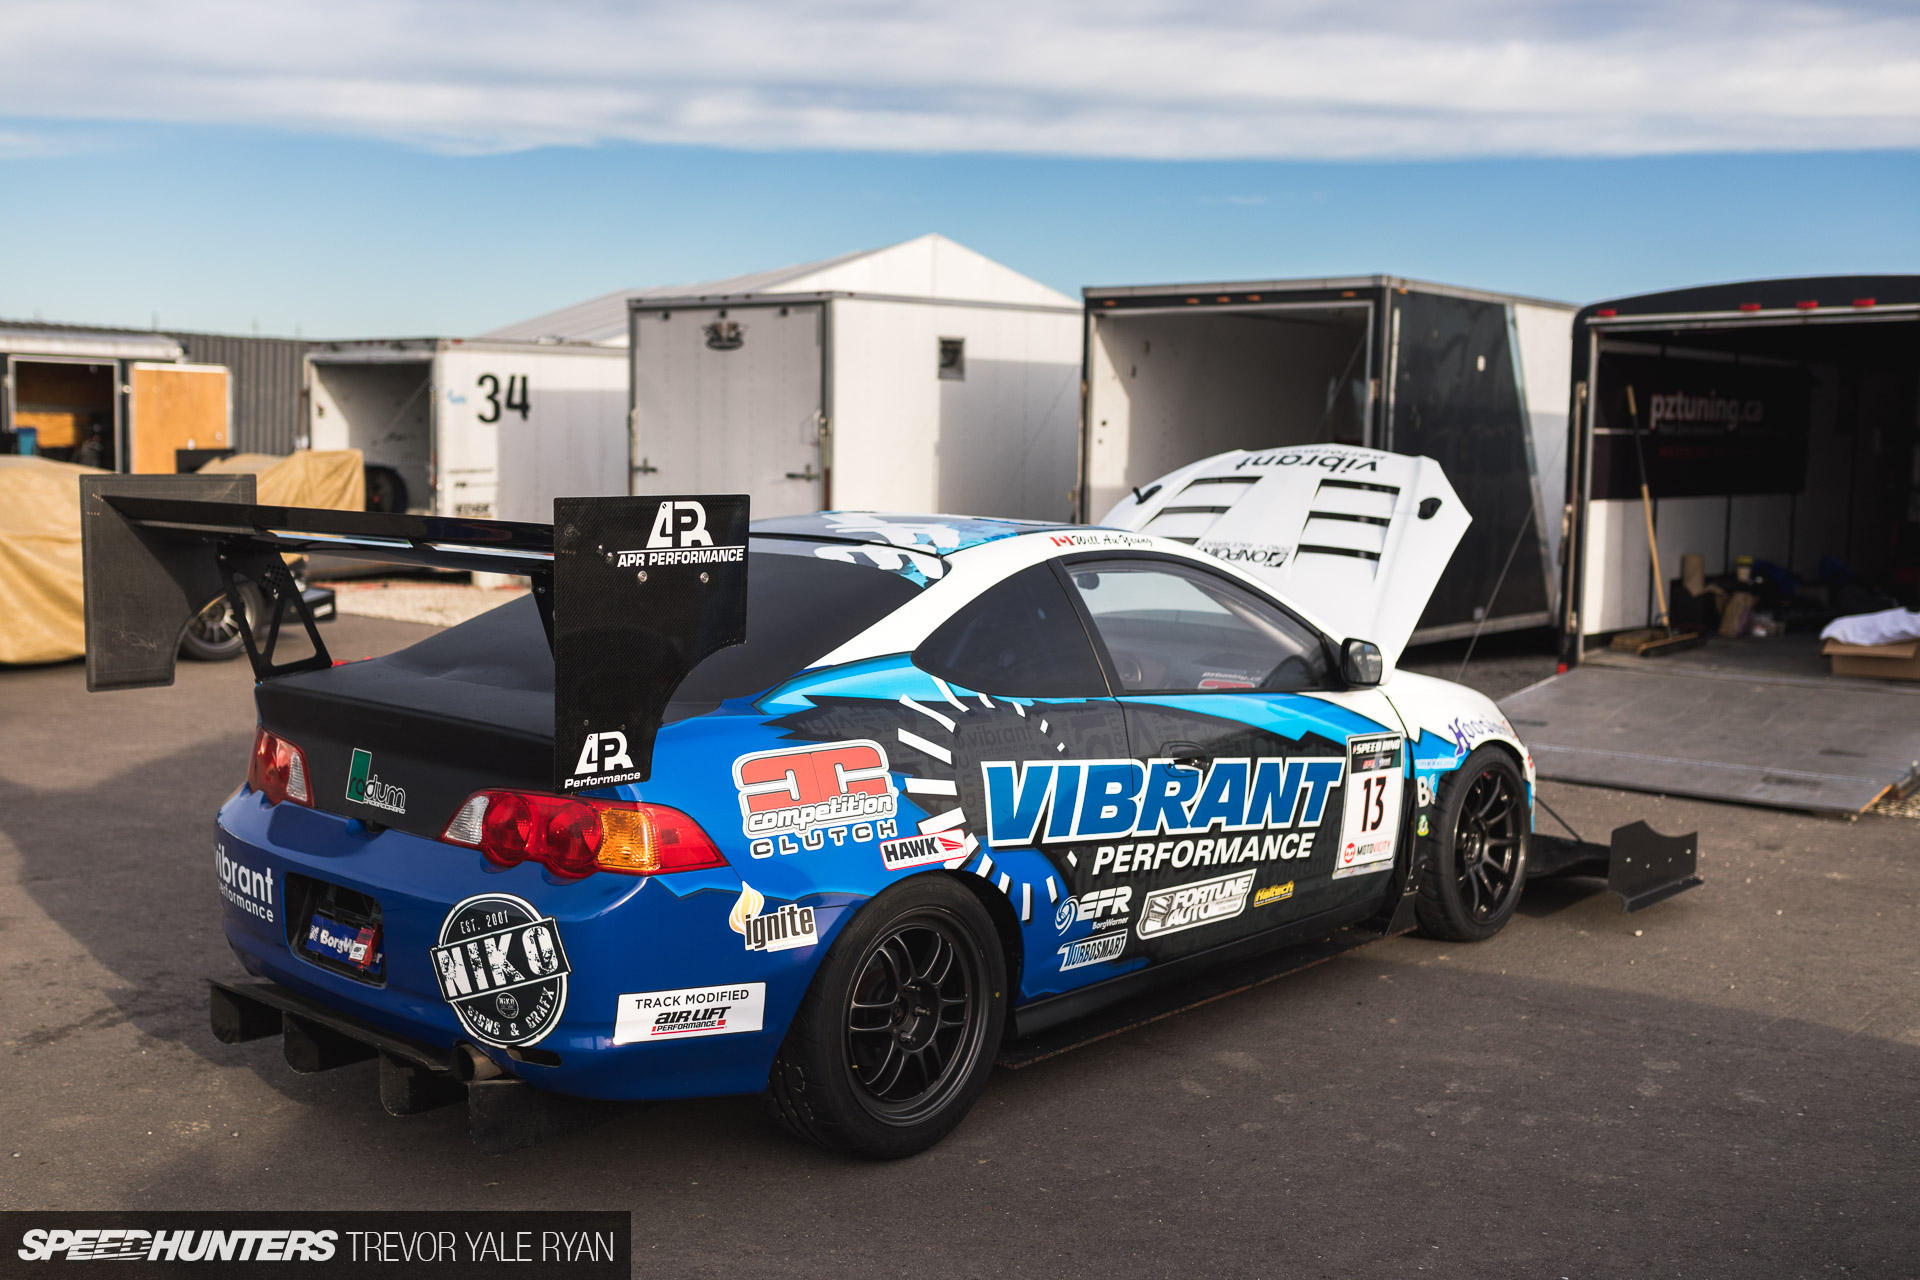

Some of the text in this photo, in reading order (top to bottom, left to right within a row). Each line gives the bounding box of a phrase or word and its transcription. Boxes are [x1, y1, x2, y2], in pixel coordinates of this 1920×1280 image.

[476, 373, 532, 424] 34
[1650, 389, 1764, 430] pztuning.ca
[1235, 455, 1377, 473] vibrant
[617, 548, 744, 567] APR PERFORMANCE
[564, 772, 641, 788] Performance
[747, 793, 893, 833] competition
[981, 757, 1347, 848] VIBRANT
[1361, 775, 1387, 832] 13
[752, 820, 897, 857] CLUTCH
[883, 837, 939, 862] HAWK
[1092, 832, 1316, 876] PERFORMANCE
[1076, 885, 1133, 922] EFR
[1173, 877, 1252, 907] FORTUNE
[1255, 881, 1293, 903] Haltech
[460, 910, 509, 935] EST. 2001
[745, 905, 815, 950] ignite
[1092, 916, 1129, 930] BorgWarner
[1166, 901, 1215, 927] AUTO
[320, 929, 383, 964] BorgWr
[437, 925, 559, 998] NIKO
[1058, 935, 1128, 971] TURBOSMART
[466, 1005, 501, 1036] SIGNS
[510, 1022, 520, 1037] &
[525, 986, 555, 1029] GRAFX
[635, 989, 750, 1010] TRACK MODIFIED
